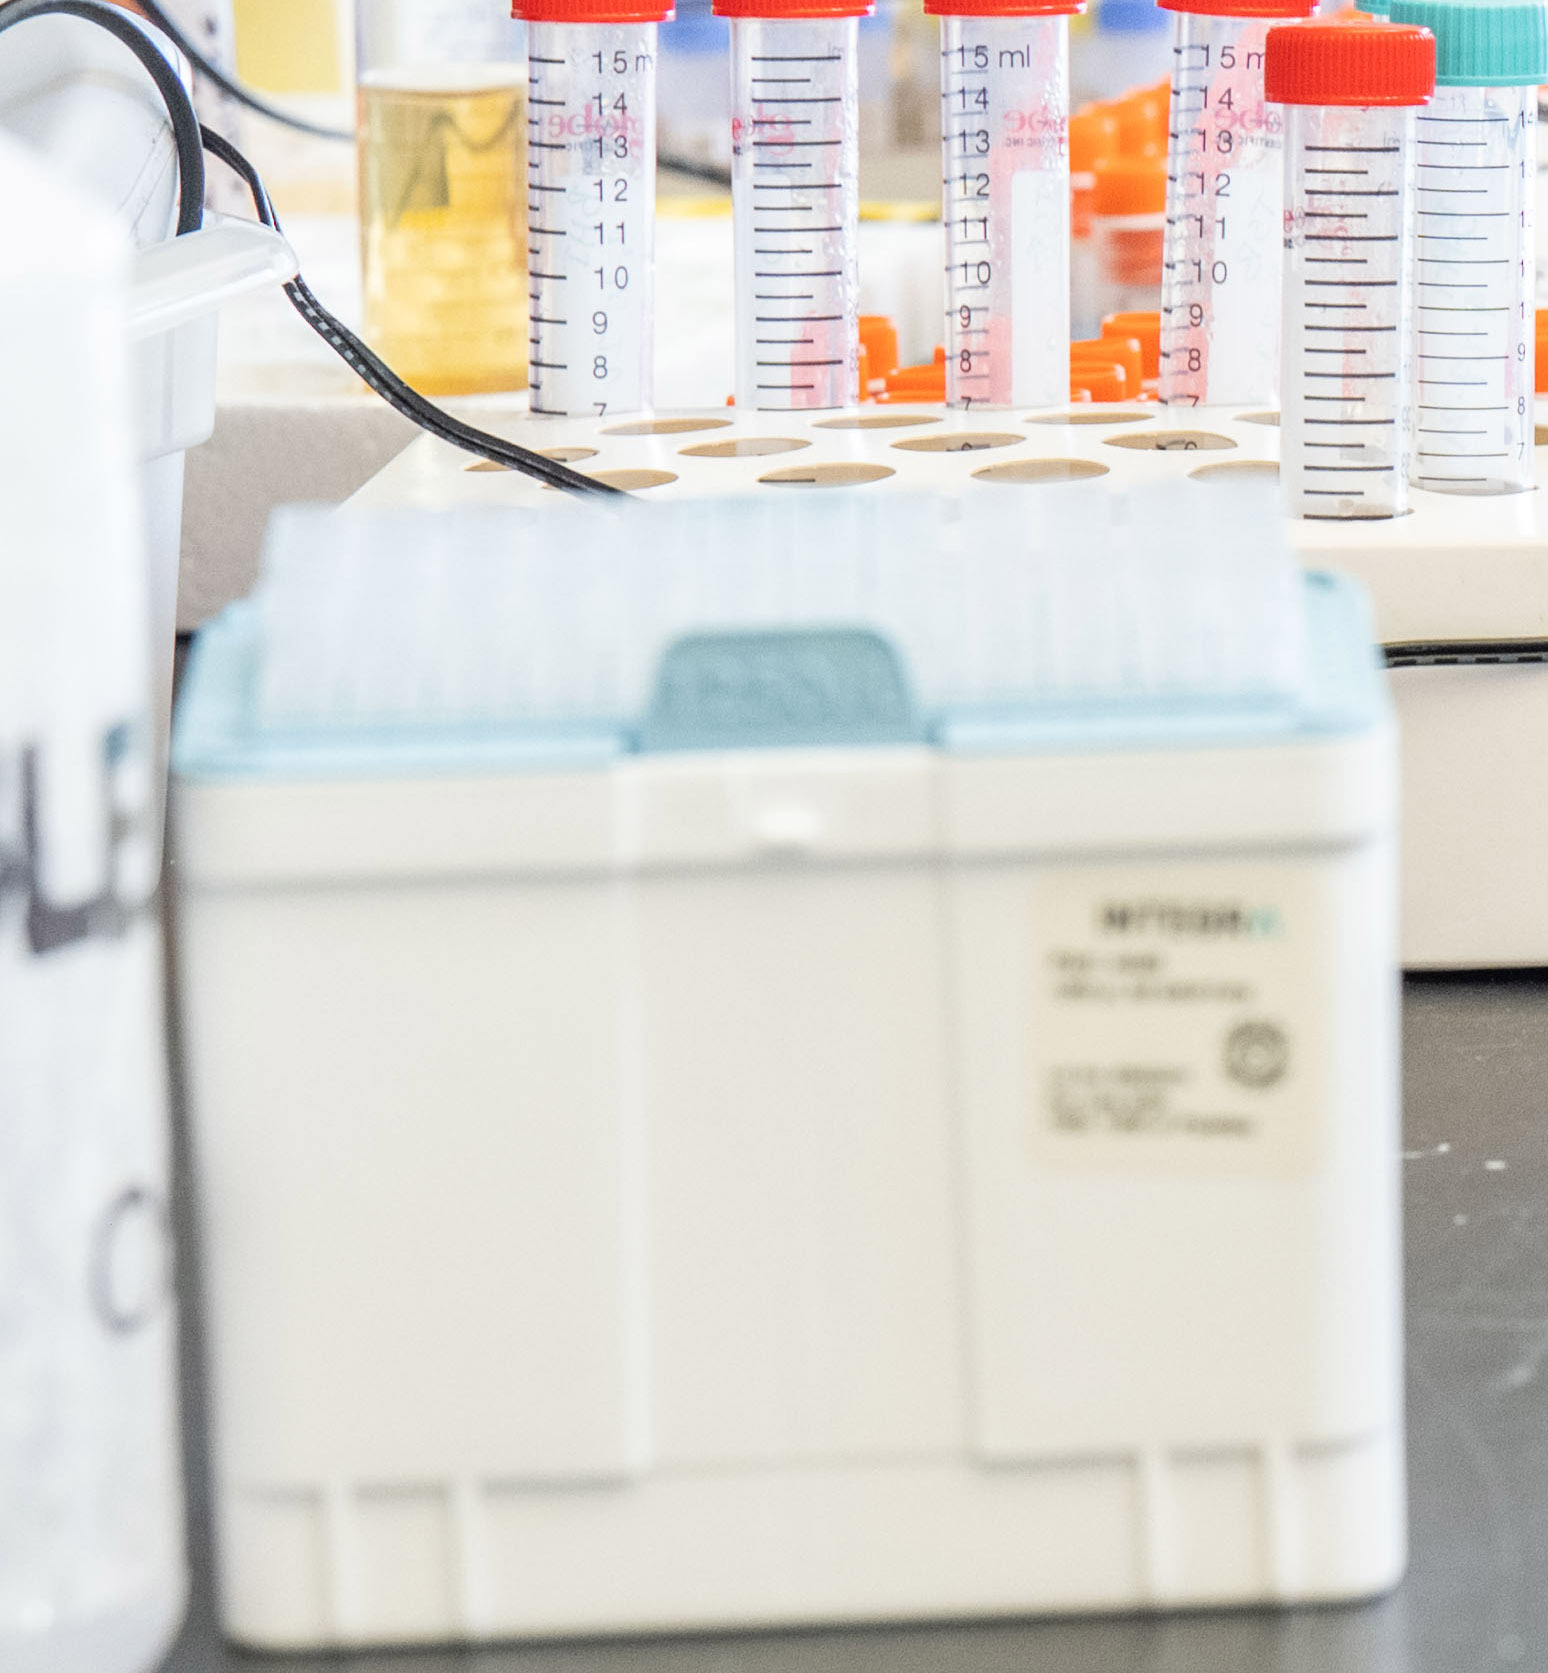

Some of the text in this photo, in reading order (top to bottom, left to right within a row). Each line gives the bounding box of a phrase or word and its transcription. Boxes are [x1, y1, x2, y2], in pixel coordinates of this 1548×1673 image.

[592, 50, 628, 74] 15
[958, 44, 1030, 68] 15 ml
[1202, 44, 1236, 69] 15
[592, 92, 628, 115] 14
[958, 86, 989, 109] 14
[1202, 86, 1234, 110] 14
[592, 135, 628, 159] 13
[958, 129, 990, 153] 13
[1201, 129, 1233, 153] 13
[593, 179, 628, 202] 12
[959, 173, 990, 196] 12
[1199, 172, 1231, 196] 12
[593, 221, 625, 245] 11
[960, 216, 988, 240] 11
[1195, 215, 1225, 239] 11
[594, 266, 629, 290] 10
[960, 260, 991, 284] 10
[1193, 259, 1227, 284] 10
[592, 311, 608, 335] 9
[960, 304, 972, 328] 9
[1189, 303, 1203, 327] 9
[960, 349, 972, 373] 8
[1187, 348, 1202, 372] 8
[1517, 343, 1526, 361] 9
[592, 355, 608, 379] 8
[1517, 396, 1526, 415] 8
